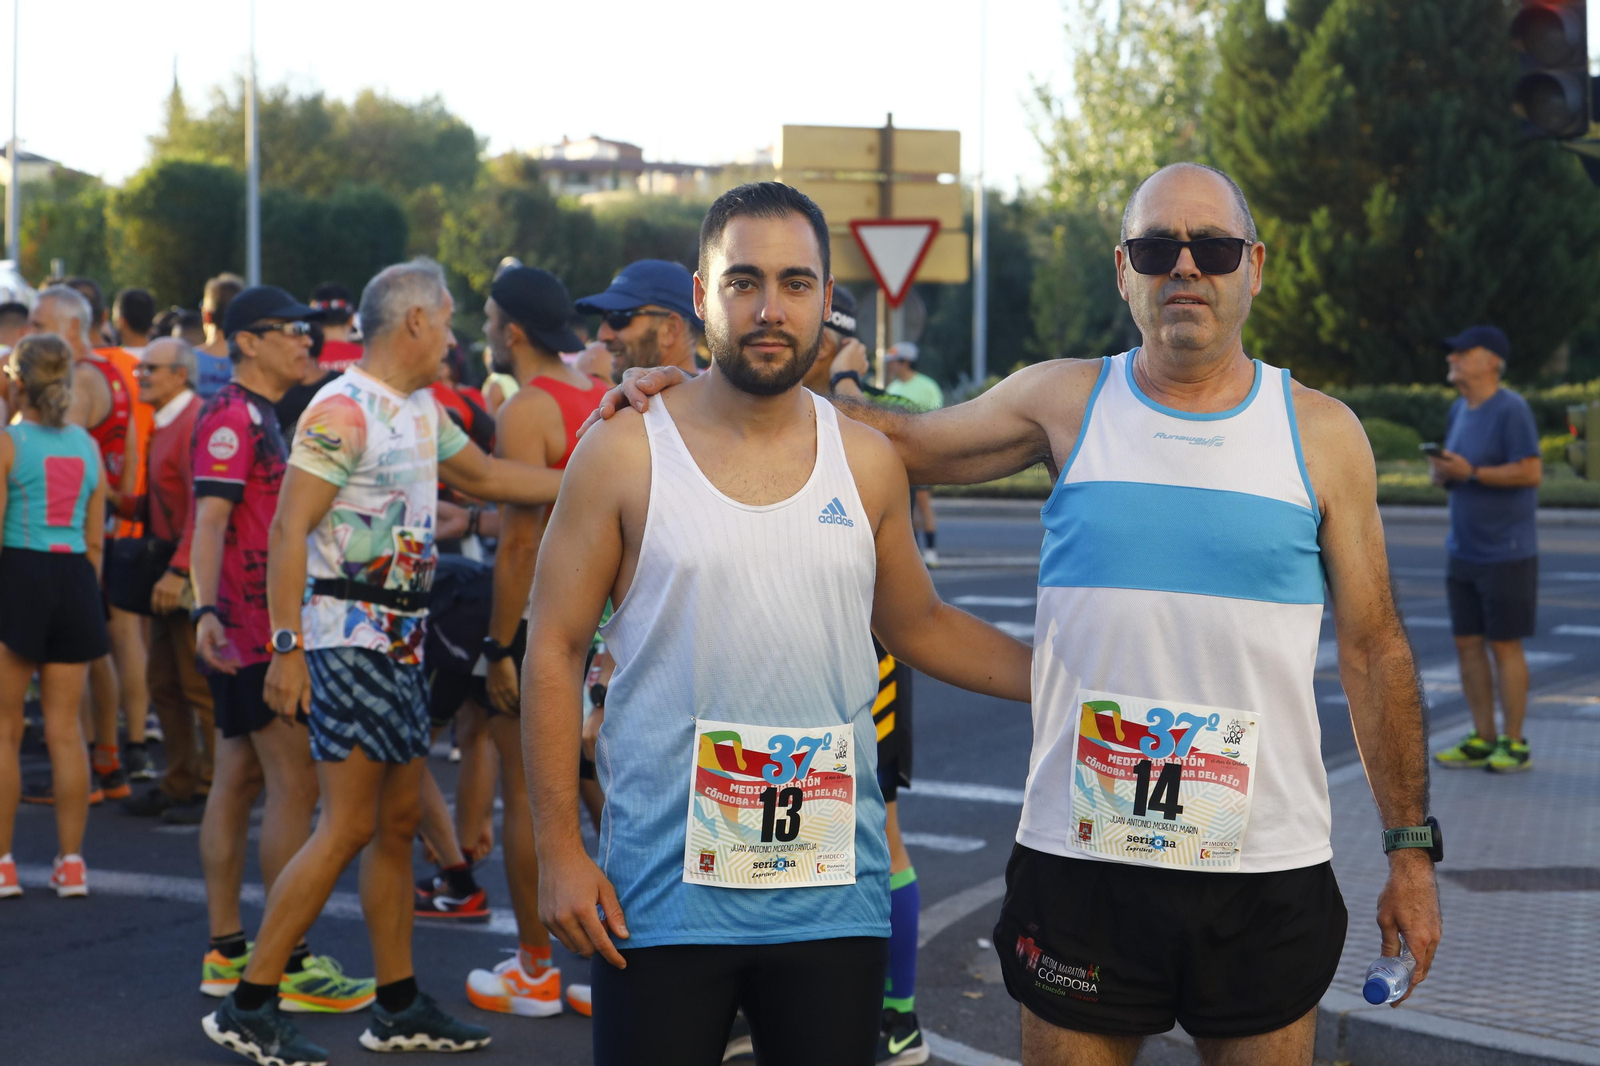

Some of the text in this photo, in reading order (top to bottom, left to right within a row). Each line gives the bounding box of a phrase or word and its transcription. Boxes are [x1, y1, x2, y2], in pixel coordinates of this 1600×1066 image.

[818, 513, 854, 527] adidas
[1223, 736, 1241, 745] VAR
[1085, 755, 1125, 777] CÓRDOBA
[1198, 770, 1217, 780] DEL
[1220, 771, 1240, 787] RÍO
[705, 786, 749, 806] CÓRDOBA
[815, 788, 847, 799] DEL RÍO
[1133, 759, 1184, 821] 14
[760, 787, 803, 842] 13
[1109, 815, 1126, 825] JUAN
[1126, 818, 1152, 829] ANTONIO
[1152, 821, 1178, 833] MORENO
[730, 842, 817, 853] JUAN ANTONIO MORENO PANTOJA
[1127, 834, 1176, 848] serizona
[753, 858, 796, 869] serizona
[1041, 954, 1087, 979] MEDIA MARATÓN
[1038, 967, 1098, 994] CÓRDOBA
[1041, 984, 1066, 996] EDICIÓN
